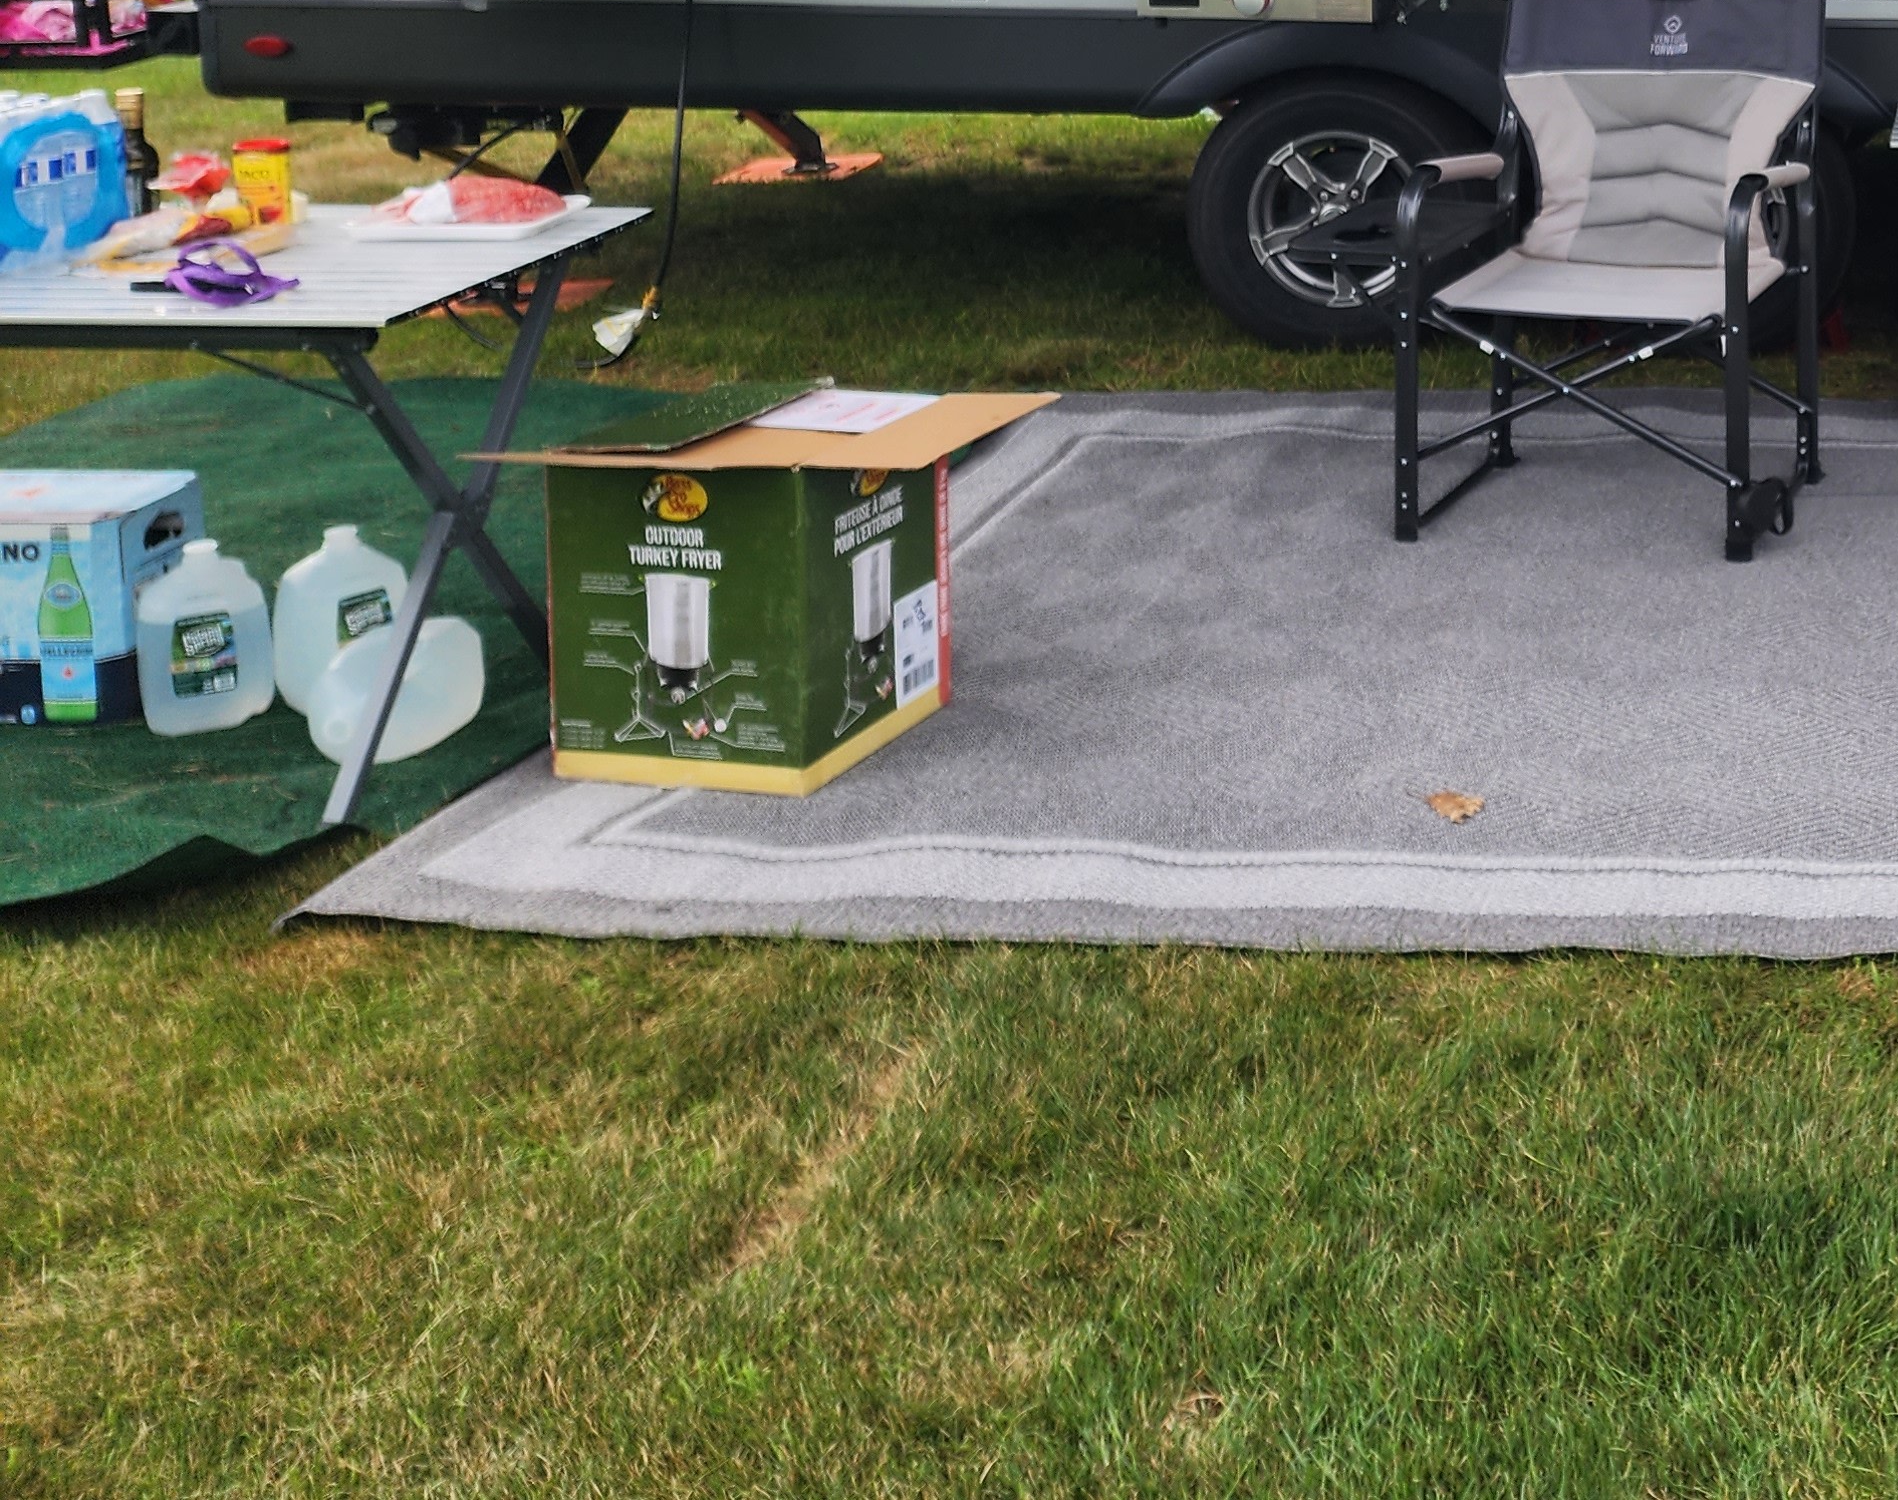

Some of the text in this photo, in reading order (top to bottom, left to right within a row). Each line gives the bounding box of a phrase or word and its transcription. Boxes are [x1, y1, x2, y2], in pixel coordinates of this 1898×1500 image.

[645, 525, 704, 548] OUTDOOR
[627, 544, 722, 571] TURKEY FRYER
